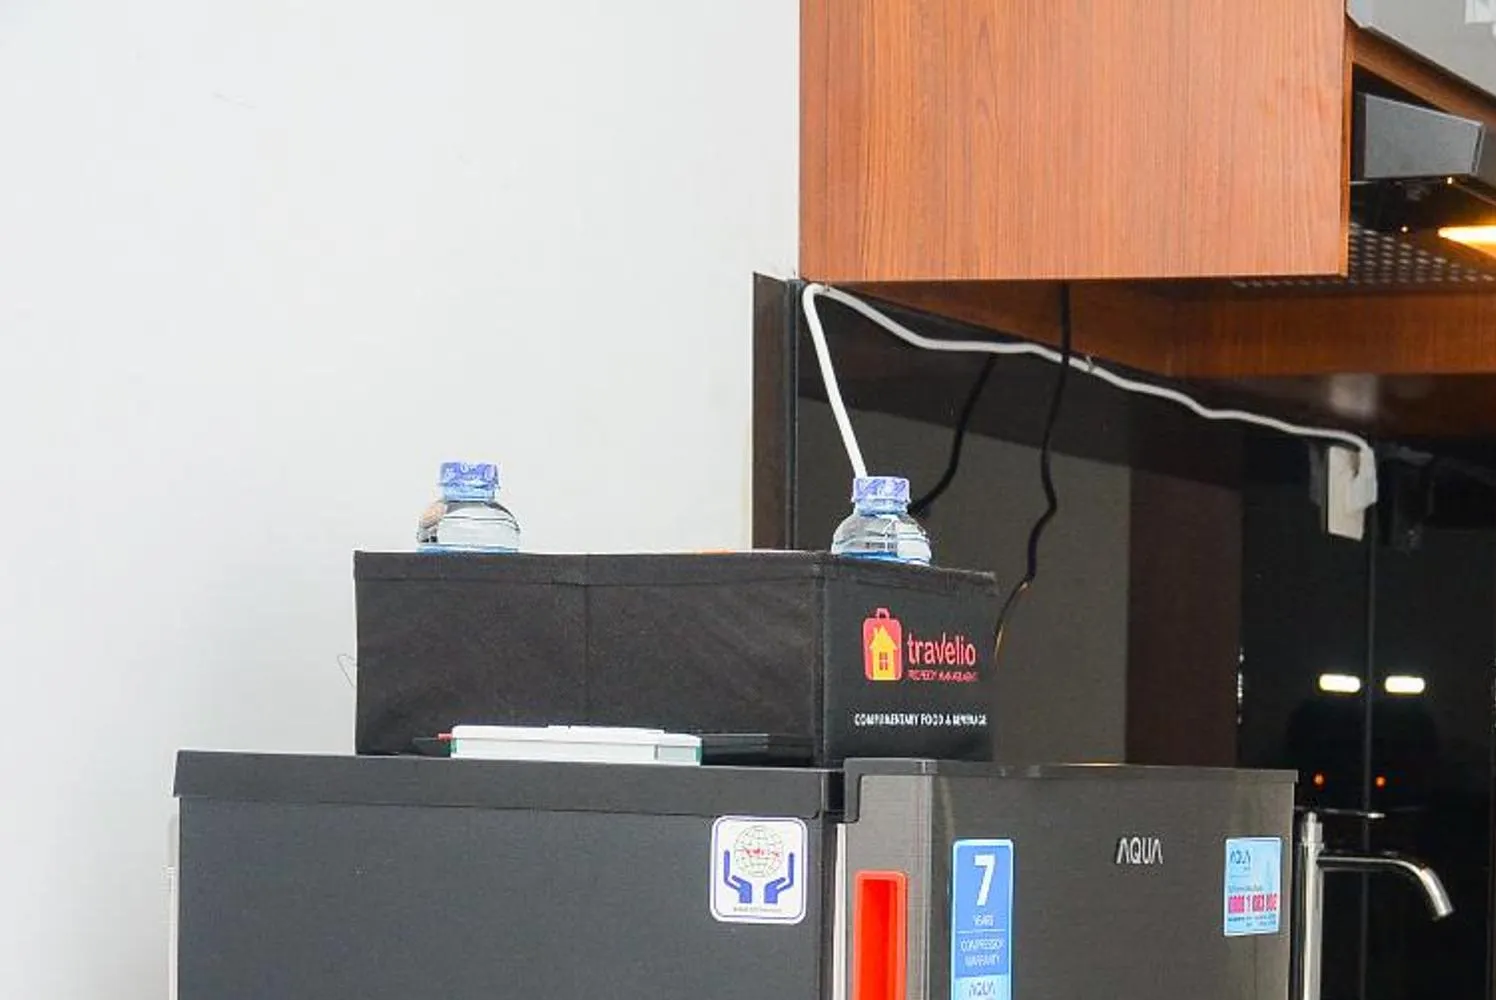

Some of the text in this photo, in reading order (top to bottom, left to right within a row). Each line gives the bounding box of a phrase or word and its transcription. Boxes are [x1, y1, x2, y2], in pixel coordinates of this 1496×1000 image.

[907, 631, 977, 667] travelio
[920, 713, 944, 726] FOOD
[1116, 836, 1164, 865] AQUA
[974, 853, 997, 907] 7
